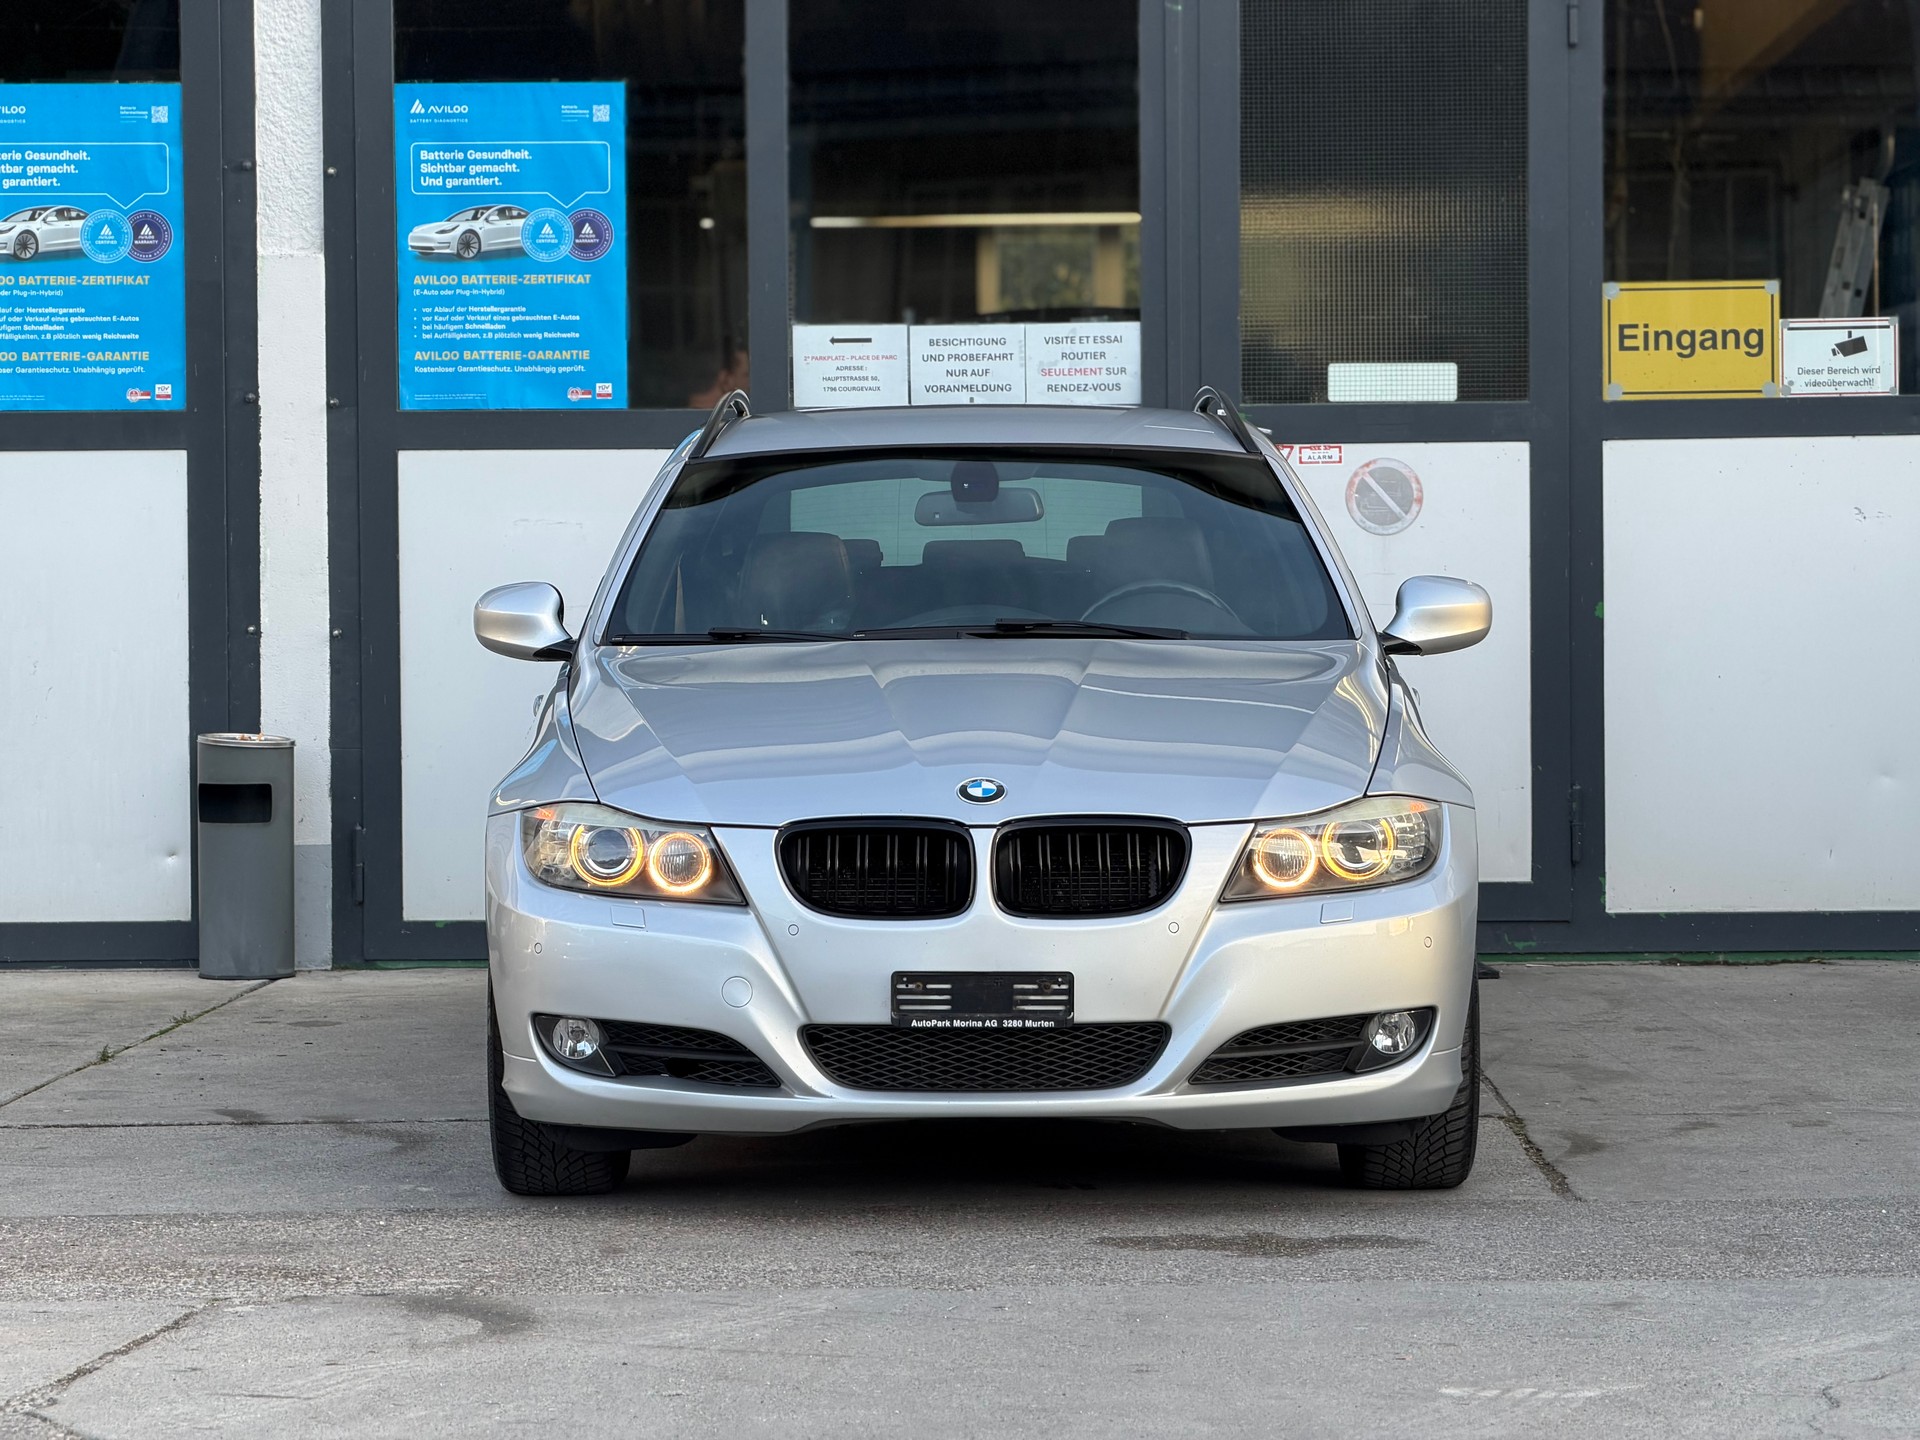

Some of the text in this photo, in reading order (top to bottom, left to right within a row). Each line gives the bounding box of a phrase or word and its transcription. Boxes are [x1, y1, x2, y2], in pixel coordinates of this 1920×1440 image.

[0, 105, 26, 114] ILOO
[427, 105, 469, 114] AVILOO
[24, 150, 91, 161] Gesundheit.
[420, 149, 532, 160] Batterie Gesundheit.
[0, 163, 79, 176] tbar gemacht.
[420, 162, 520, 175] Sichtbar gemacht.
[2, 175, 61, 189] garantiert.
[420, 175, 503, 189] Und garantiert.
[18, 275, 151, 286] BATTERIE-ZERTIFIKAT
[413, 274, 592, 285] AVILOO BATTERIE-ZERTIFIKAT
[12, 289, 64, 298] Plug-in-Hybrid)
[455, 288, 505, 297] Plug-in-Hybrid)
[13, 306, 25, 314] der
[26, 306, 86, 315] Herstellergarantie
[433, 305, 455, 313] Ablauf
[468, 305, 527, 314] Herstellergarantie
[70, 315, 112, 324] gebrauchten
[511, 314, 552, 322] gebrauchten
[421, 323, 433, 331] bei
[52, 333, 81, 341] plötzlich
[81, 333, 102, 341] wenig
[102, 332, 140, 340] Reichweite
[421, 332, 433, 340] bei
[494, 331, 522, 340] plötzlich
[522, 332, 543, 340] wenig
[543, 331, 580, 339] Reichweite
[1044, 335, 1123, 345] VISITE ET ESSAI
[928, 337, 1007, 347] BESICHTIGUNG
[1617, 323, 1765, 359] Eingang
[22, 351, 150, 361] BATTERIE-GARANTIE
[414, 349, 591, 361] AVILOO BATTERIE-GARANTIE
[921, 352, 1014, 362] UND PROBEFAHRT
[1061, 351, 1107, 360] ROUTIER
[15, 366, 72, 374] Garantieschutz.
[73, 366, 116, 375] Unabhängig
[117, 365, 146, 375] geprüft.
[414, 364, 587, 374] Kostenloser Garantieschutz. Unabhängig geprüft.
[945, 368, 991, 378] NUR AUF
[1040, 366, 1127, 376] SEULEMENT SUR
[1797, 365, 1882, 375] Dieser Bereich wird
[1046, 382, 1122, 392] RENDEZ-VOUS
[1804, 377, 1875, 387] videoüberwacht!
[924, 383, 1012, 393] VORANMELDUNG
[911, 1019, 1055, 1028] AutoPark Morina AG 3280 Murten
